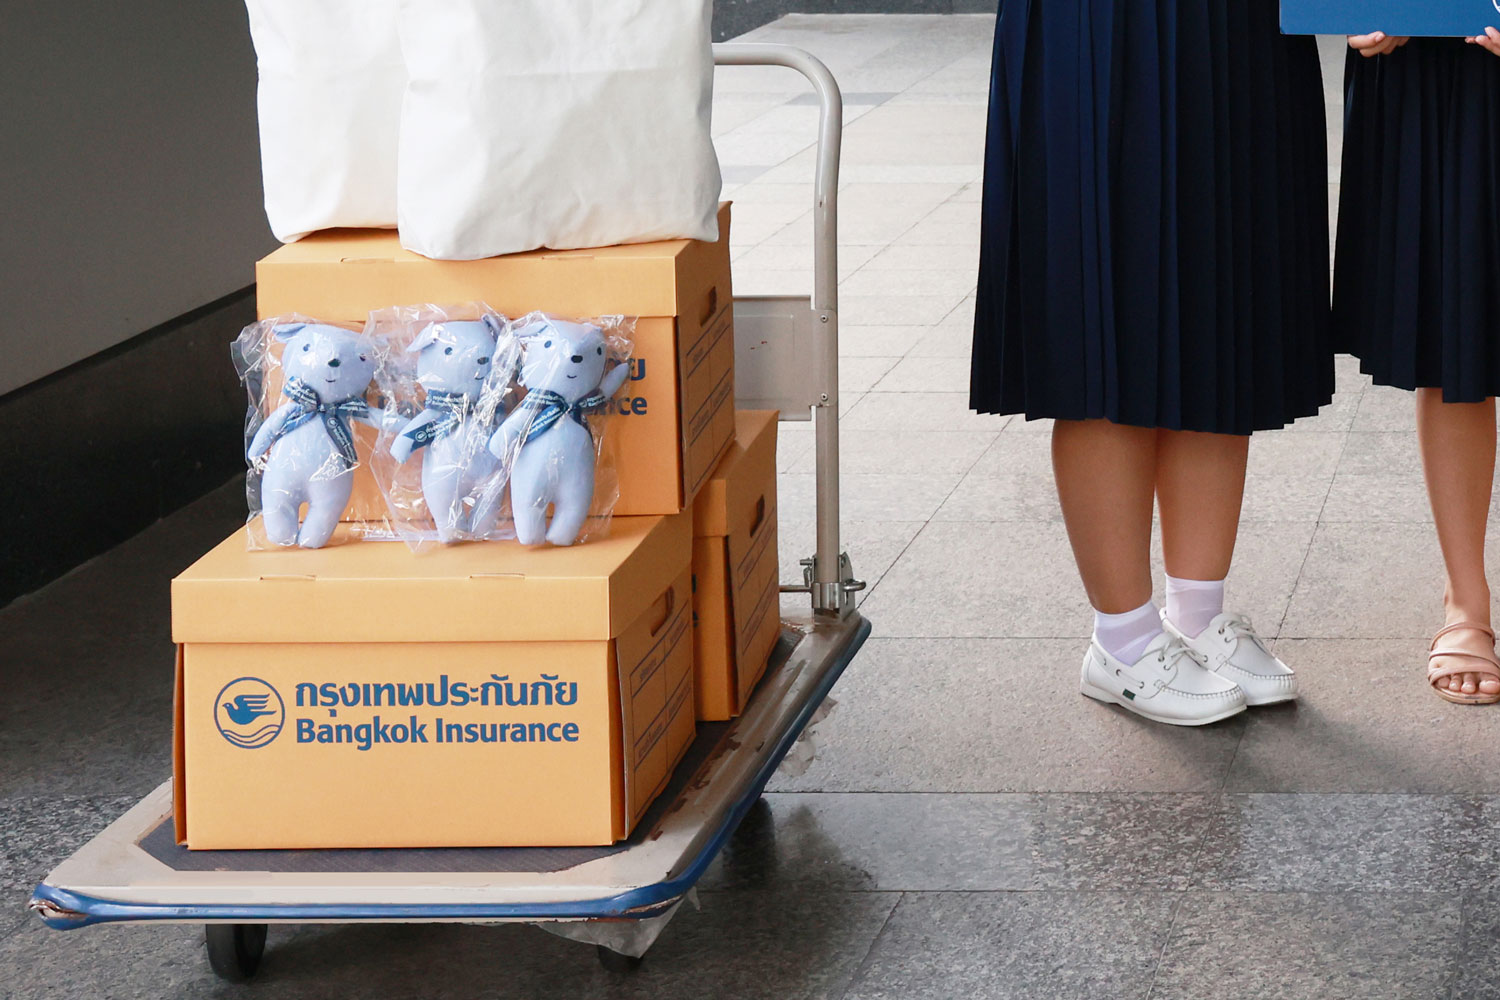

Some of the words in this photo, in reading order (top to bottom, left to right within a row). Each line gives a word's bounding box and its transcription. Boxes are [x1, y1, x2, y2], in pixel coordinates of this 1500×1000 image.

[295, 673, 578, 718] กรุงเทพประกันภัย
[296, 714, 428, 751] Bangkok
[436, 717, 580, 743] Insurance
